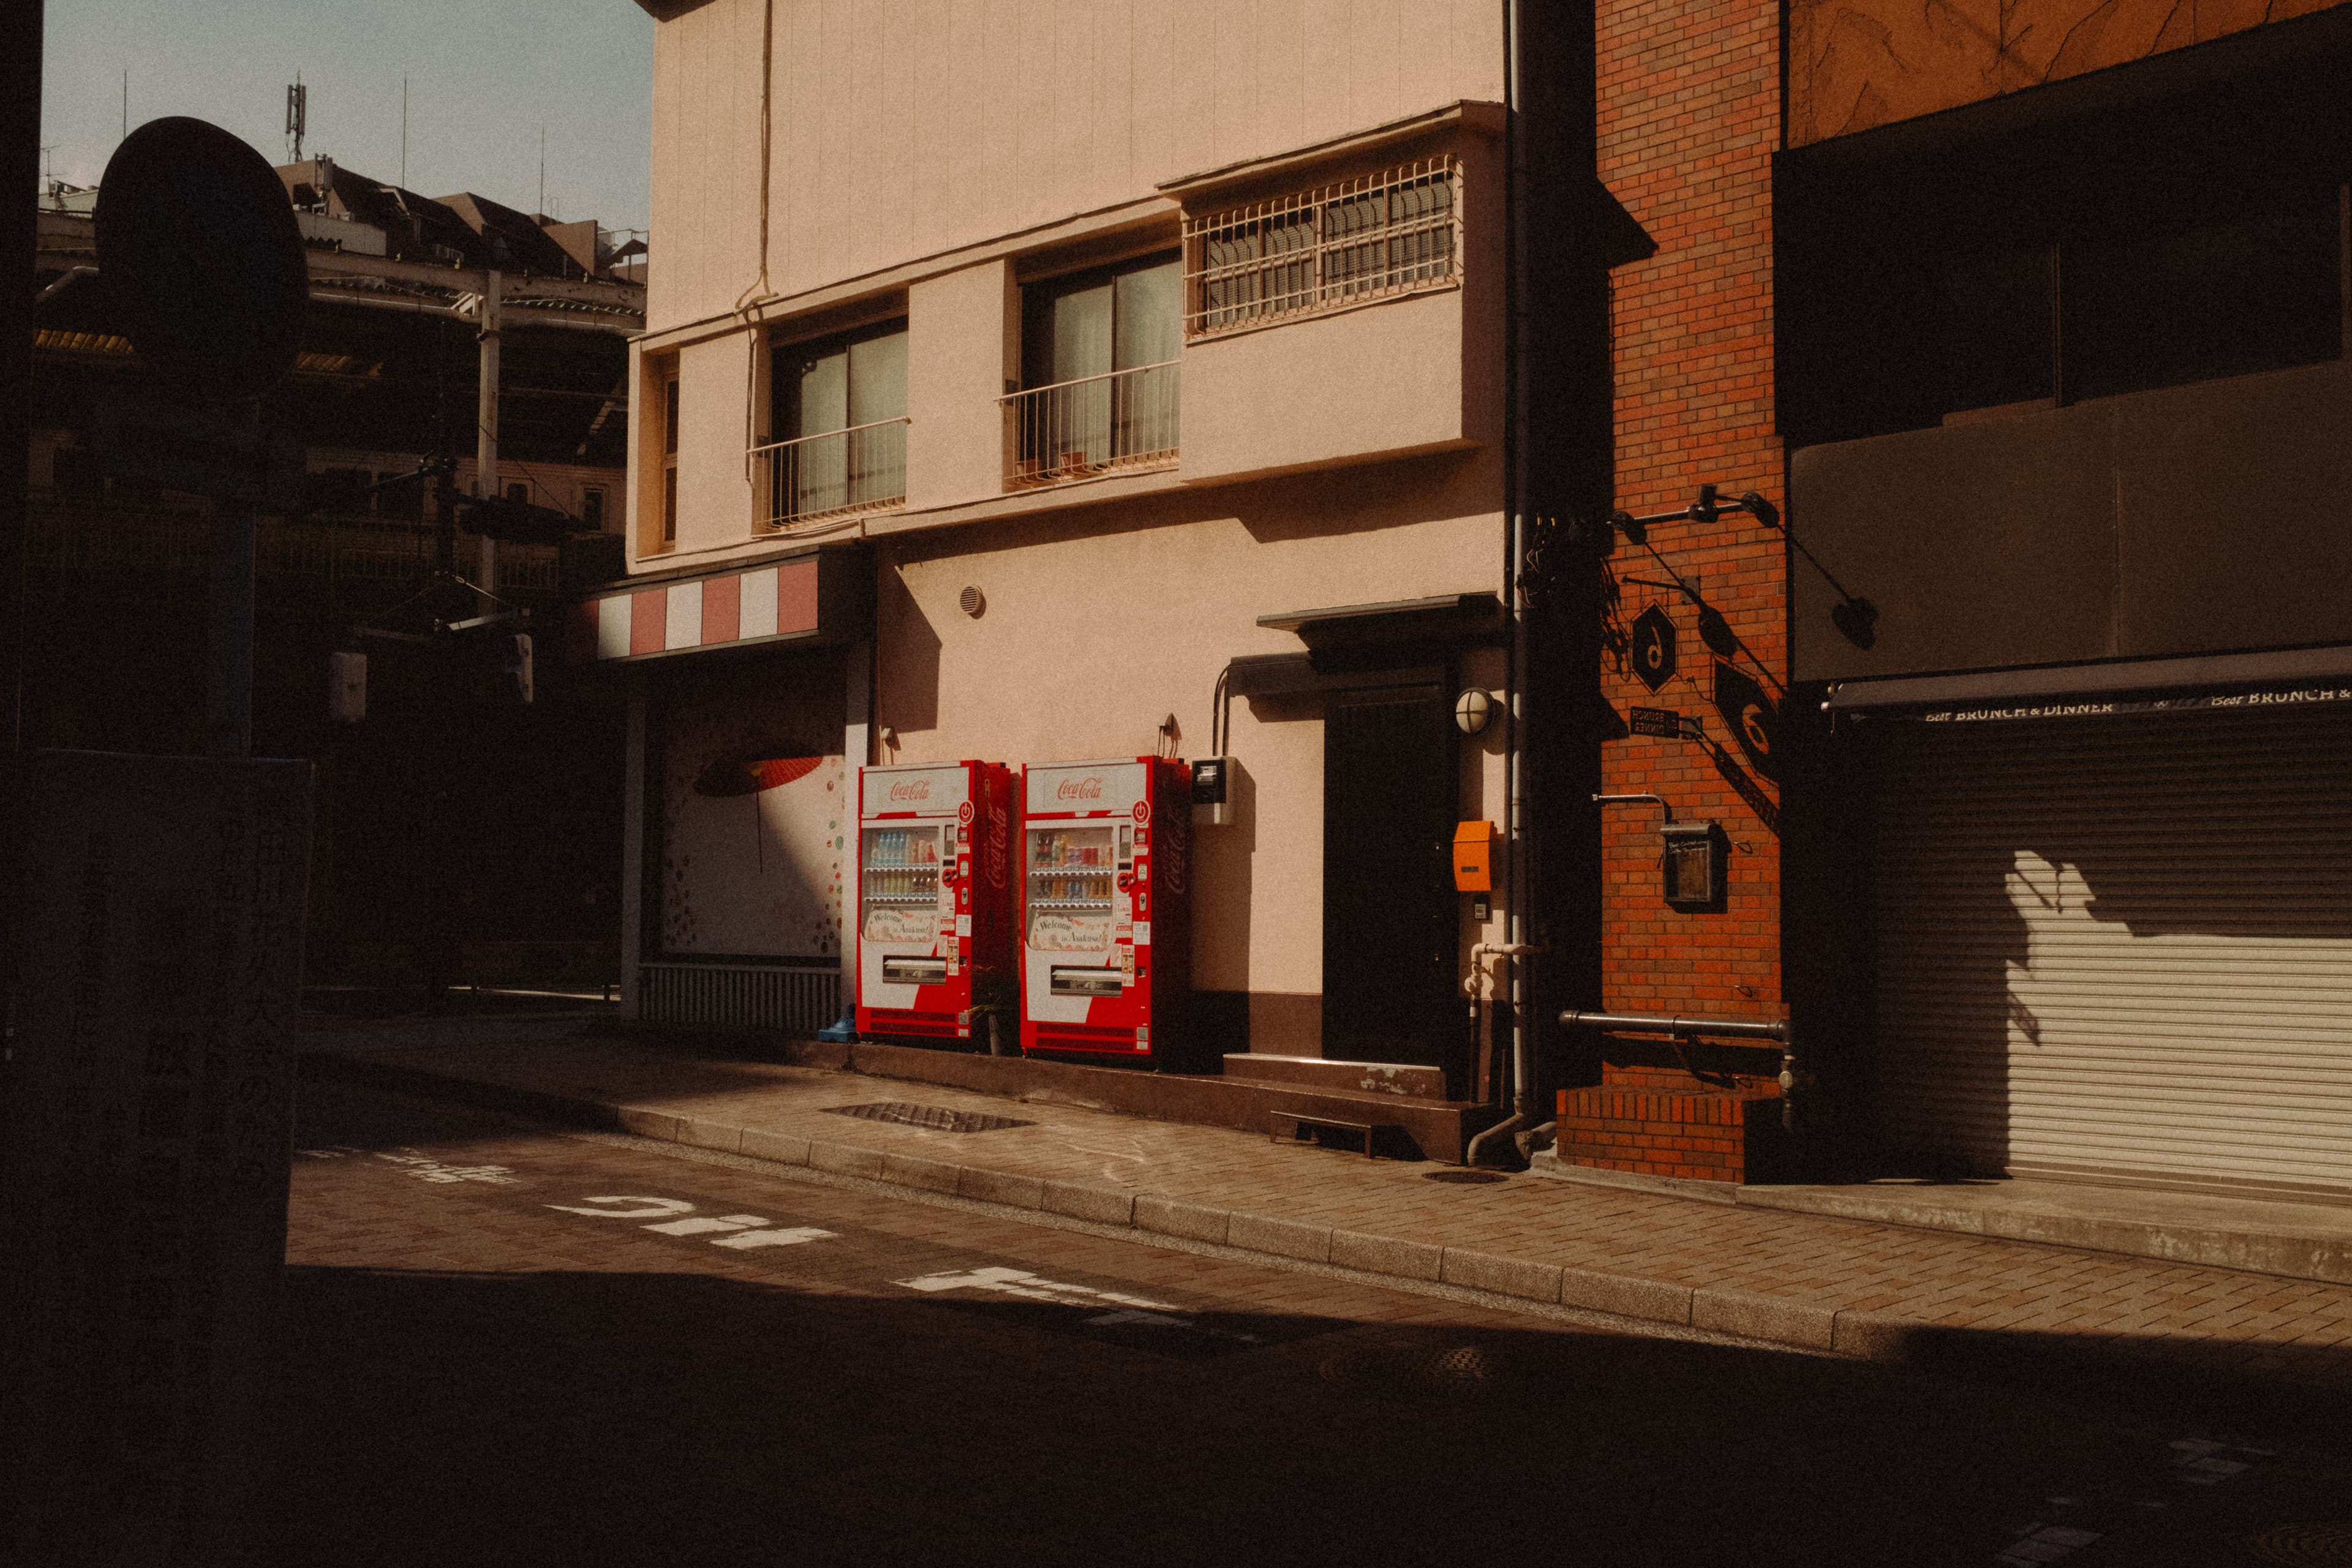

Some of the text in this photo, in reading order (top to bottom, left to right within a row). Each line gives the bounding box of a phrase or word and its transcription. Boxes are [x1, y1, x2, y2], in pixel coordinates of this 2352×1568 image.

[2248, 690, 2334, 704] BRUNCH
[2339, 688, 2351, 698] &
[1955, 708, 2026, 721] BRUNCH
[2043, 704, 2113, 717] DINNER
[890, 780, 930, 801] Coca-Cola
[1058, 777, 1102, 800] Coca-Cola
[874, 912, 902, 923] Welcome
[899, 923, 929, 933] Asakusa!
[1039, 919, 1072, 931] Welcome
[1069, 931, 1102, 943] Asakusa!
